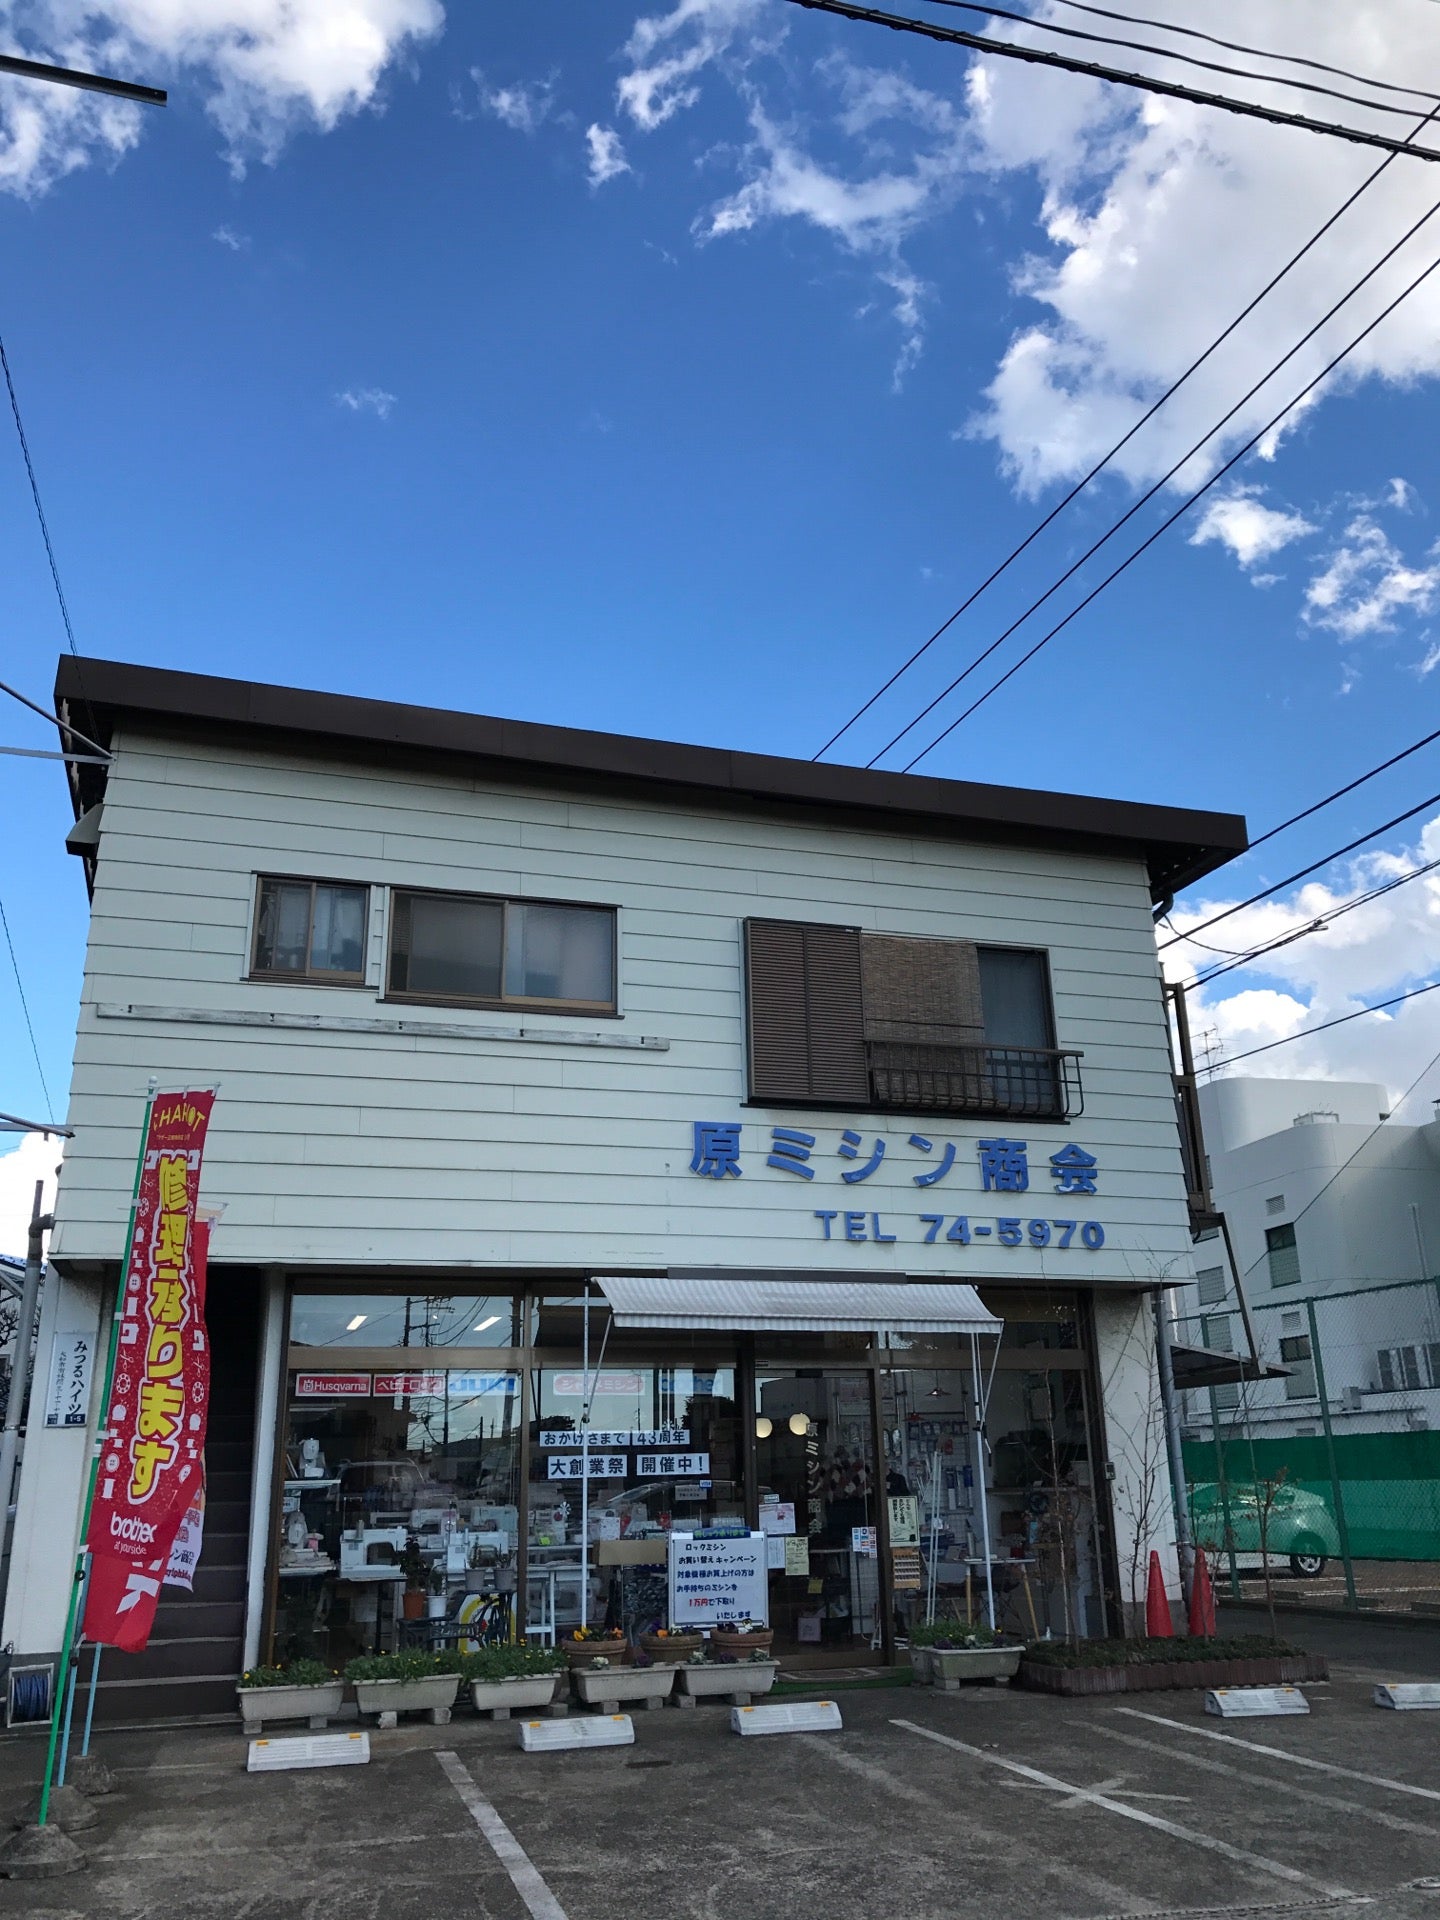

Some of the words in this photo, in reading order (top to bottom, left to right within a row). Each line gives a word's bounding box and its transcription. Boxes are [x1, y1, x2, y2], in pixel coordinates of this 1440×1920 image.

[689, 1121, 1098, 1194] 原ミシン商会
[814, 1210, 896, 1242] TEL
[920, 1213, 1105, 1250] 74-5970
[131, 1156, 188, 1498] 修理承ります
[68, 1340, 88, 1415] みつるハイツ
[314, 1380, 367, 1392] Husqvarna
[543, 1432, 625, 1445] おかげさまで
[637, 1430, 686, 1445] 43周年
[550, 1457, 624, 1476] 大創業祭
[805, 1422, 823, 1534] 原ミシン商会
[110, 1511, 158, 1544] brother
[685, 1543, 727, 1551] ロックミシン
[676, 1584, 738, 1593] お手持ちのミシンを
[716, 1611, 751, 1620] いたします
